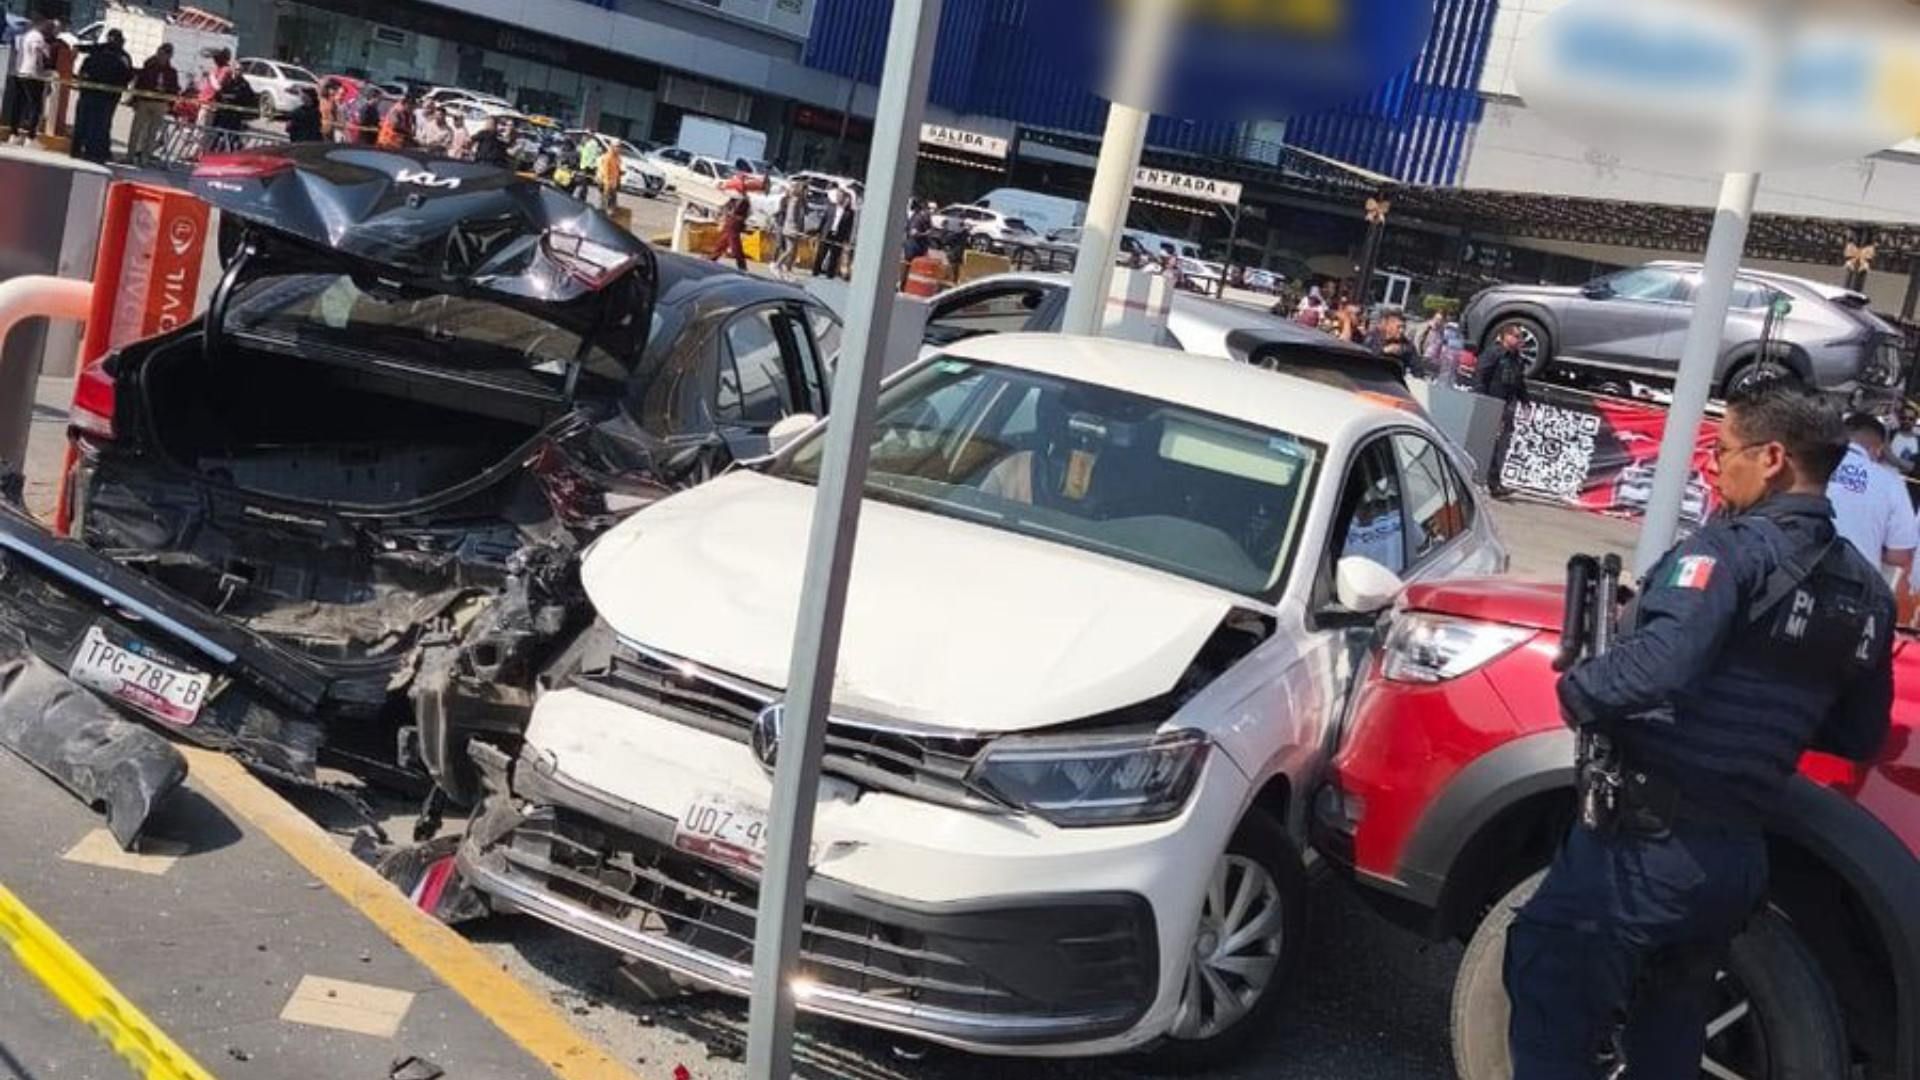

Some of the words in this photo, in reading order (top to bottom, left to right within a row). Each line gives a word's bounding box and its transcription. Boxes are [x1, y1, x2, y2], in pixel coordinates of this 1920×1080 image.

[928, 126, 984, 147] SALIDA
[1137, 169, 1216, 193] ENTRADA
[86, 638, 202, 705] TPG-787-B
[684, 802, 768, 848] UDZ-4
